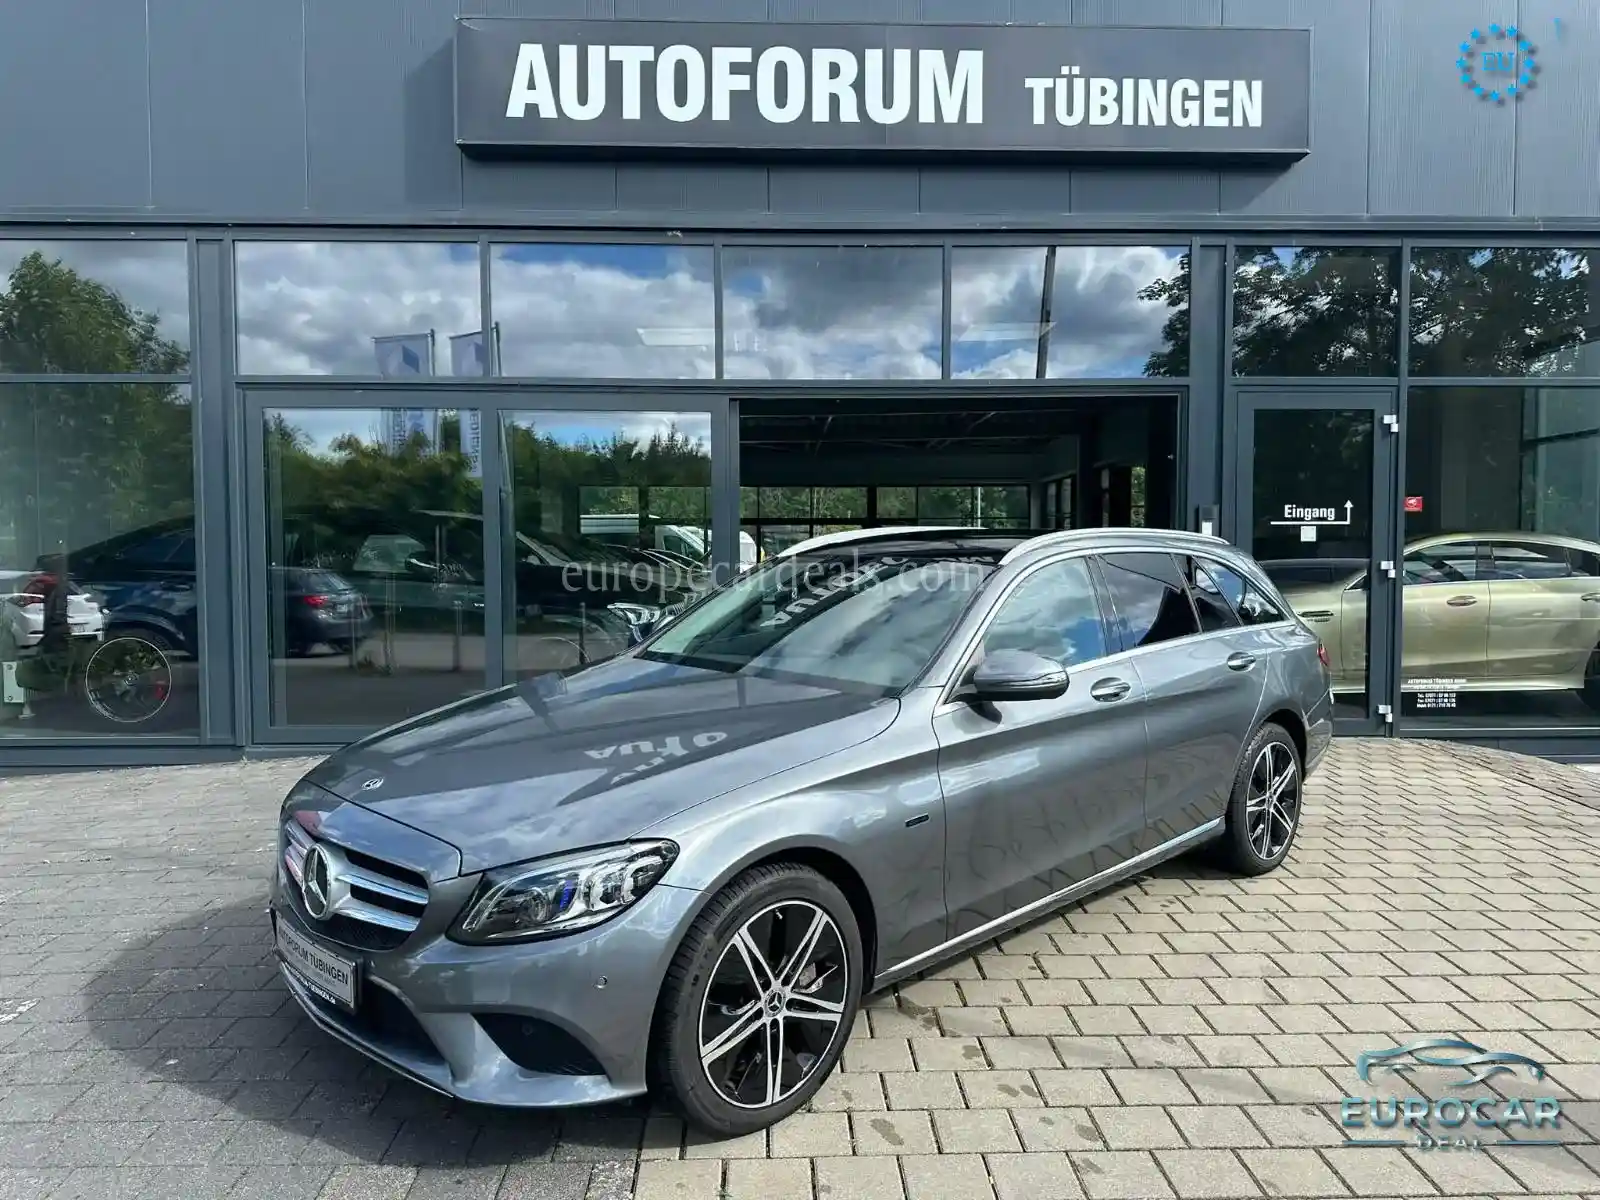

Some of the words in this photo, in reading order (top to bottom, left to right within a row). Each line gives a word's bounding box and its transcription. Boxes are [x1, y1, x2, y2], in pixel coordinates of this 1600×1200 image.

[505, 43, 984, 125] AUTOFORUM
[1024, 65, 1263, 128] TÜBINGEN
[1284, 504, 1335, 521] Eingang
[310, 951, 349, 985] TÜBINGEN
